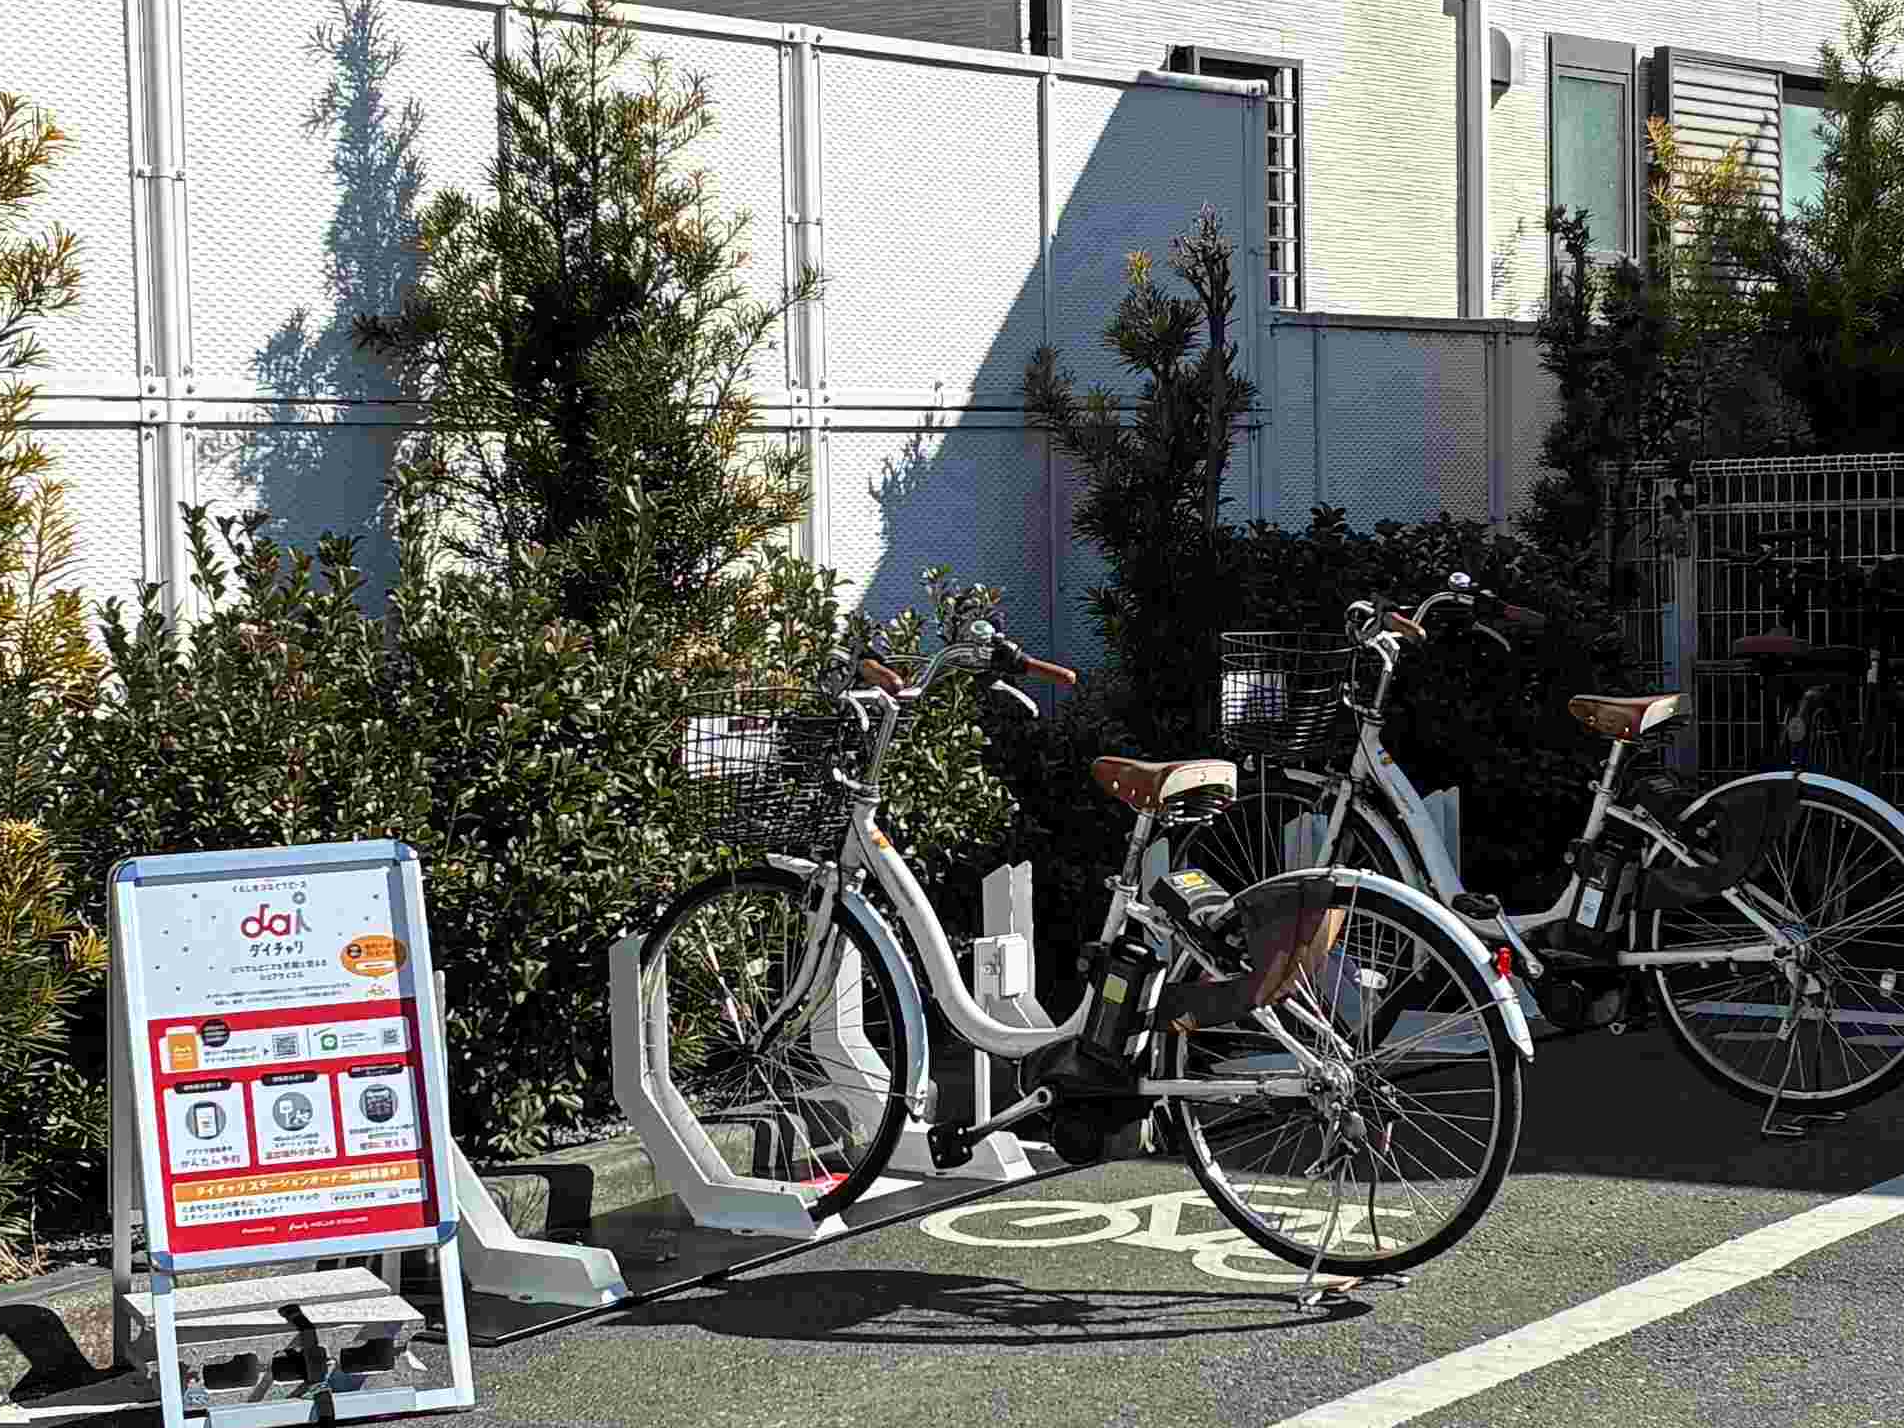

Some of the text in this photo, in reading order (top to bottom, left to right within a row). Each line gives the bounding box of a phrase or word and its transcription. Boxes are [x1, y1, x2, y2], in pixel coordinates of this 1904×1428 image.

[248, 940, 305, 958] ダイチャリ
